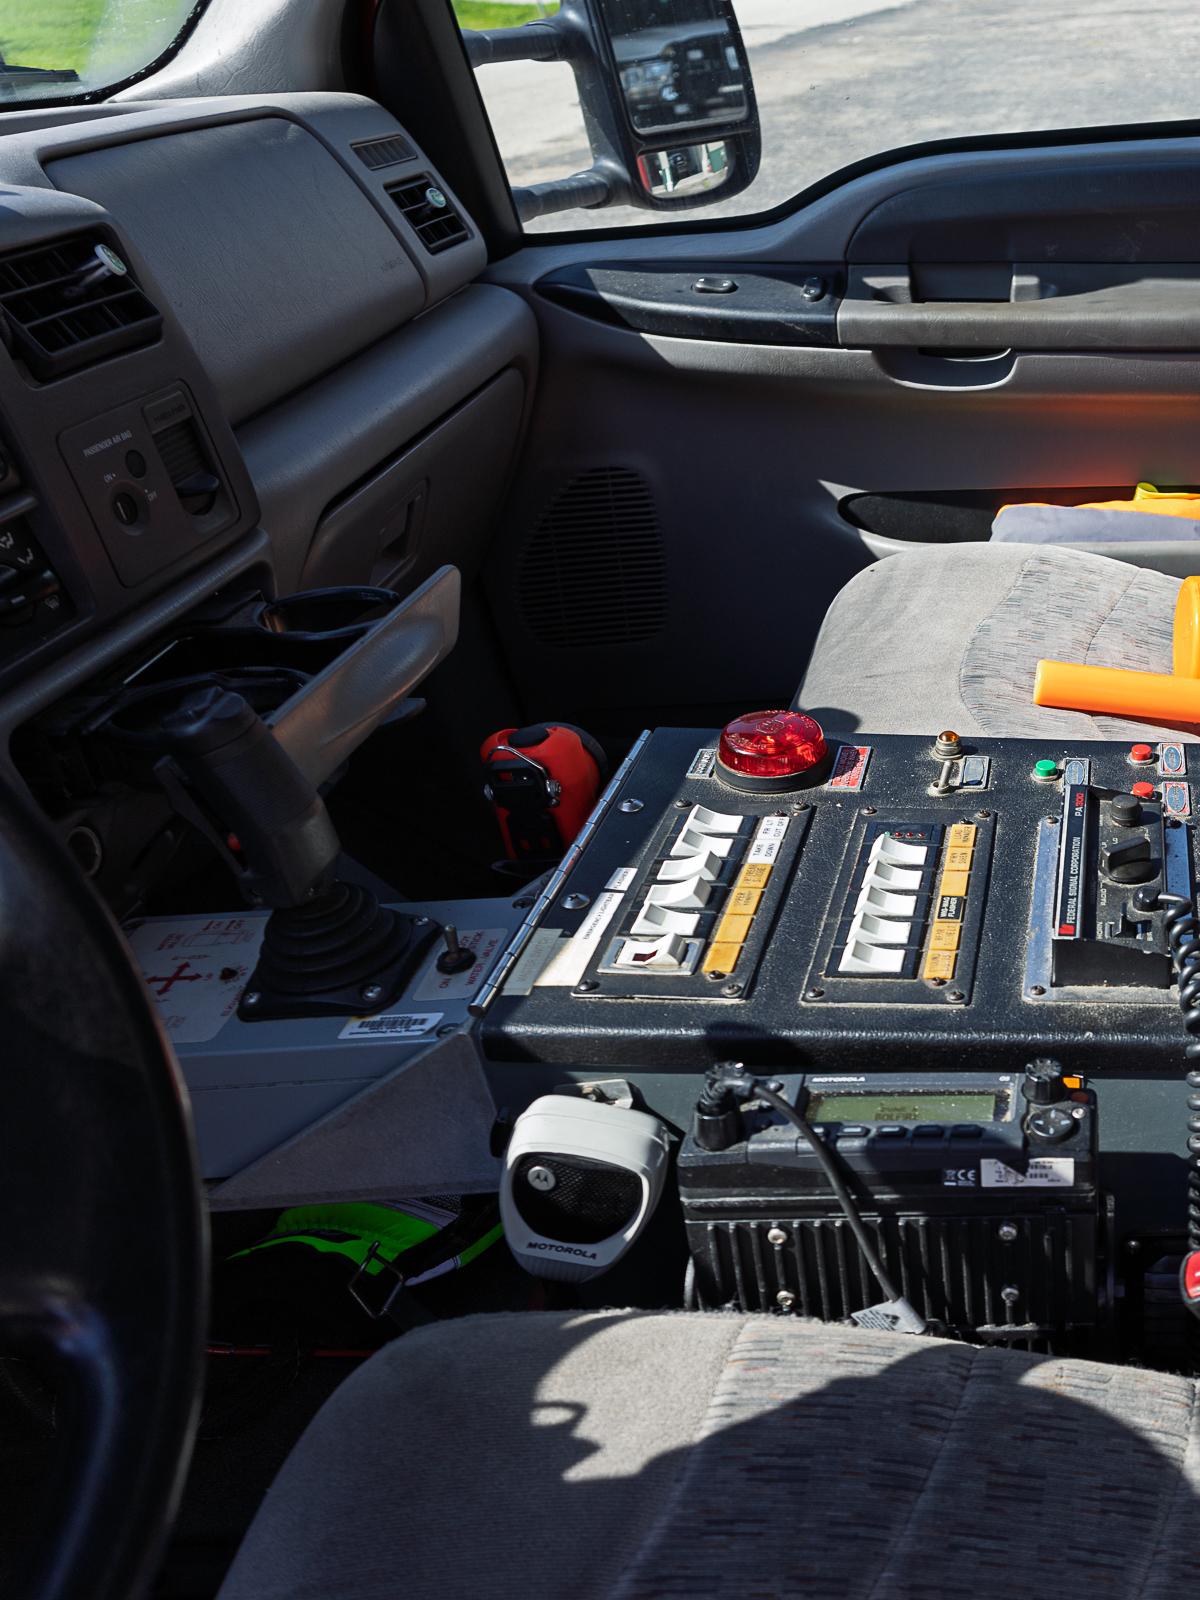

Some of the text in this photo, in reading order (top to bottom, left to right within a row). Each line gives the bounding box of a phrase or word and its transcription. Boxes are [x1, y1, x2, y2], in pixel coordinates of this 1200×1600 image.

[1074, 792, 1085, 817] PA300
[753, 843, 764, 857] TAKE
[765, 843, 774, 858] DOWN
[1066, 836, 1081, 924] FEDERAL SIGNAL CORPORATION
[940, 896, 950, 918] WIG-WAG
[948, 896, 958, 918] FLASHER
[464, 939, 499, 986] WATER VALVE
[526, 1241, 598, 1260] MOTOROLA
